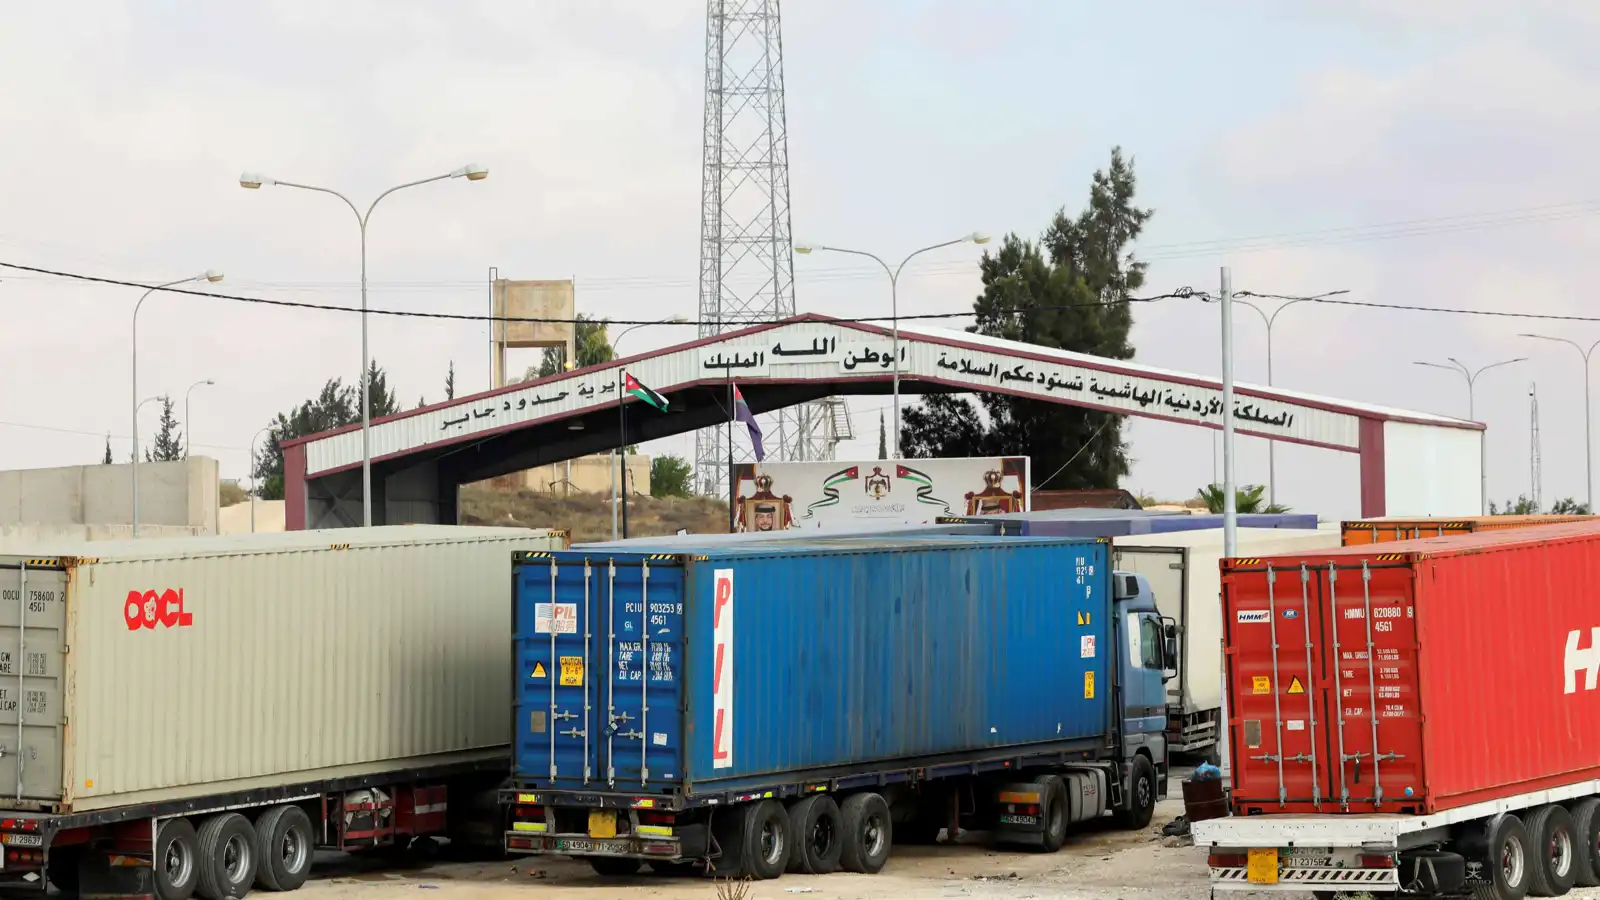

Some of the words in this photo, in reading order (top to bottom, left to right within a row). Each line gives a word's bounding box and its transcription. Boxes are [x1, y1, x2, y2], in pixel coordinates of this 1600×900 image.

[771, 336, 836, 356] الله
[844, 346, 905, 370] اوطن
[937, 352, 999, 378] السلامة
[1000, 365, 1084, 391] تستودعكم
[503, 392, 570, 411] حدود
[1090, 378, 1162, 407] الهاشمية
[1164, 386, 1224, 416] الأردنية
[440, 407, 496, 430] جابر
[1233, 400, 1294, 428] المملكة
[29, 590, 55, 602] 758600
[60, 592, 65, 602] 2
[29, 602, 46, 612] 45G1
[124, 588, 193, 631] OOCL
[554, 606, 576, 619] PIL
[625, 603, 643, 613] PCIU
[650, 603, 675, 613] 903253
[1344, 608, 1365, 619] HMMU
[1373, 607, 1401, 618] 620880
[651, 615, 667, 625] 45G1
[1564, 627, 1600, 694] H
[1343, 689, 1352, 697] NET
